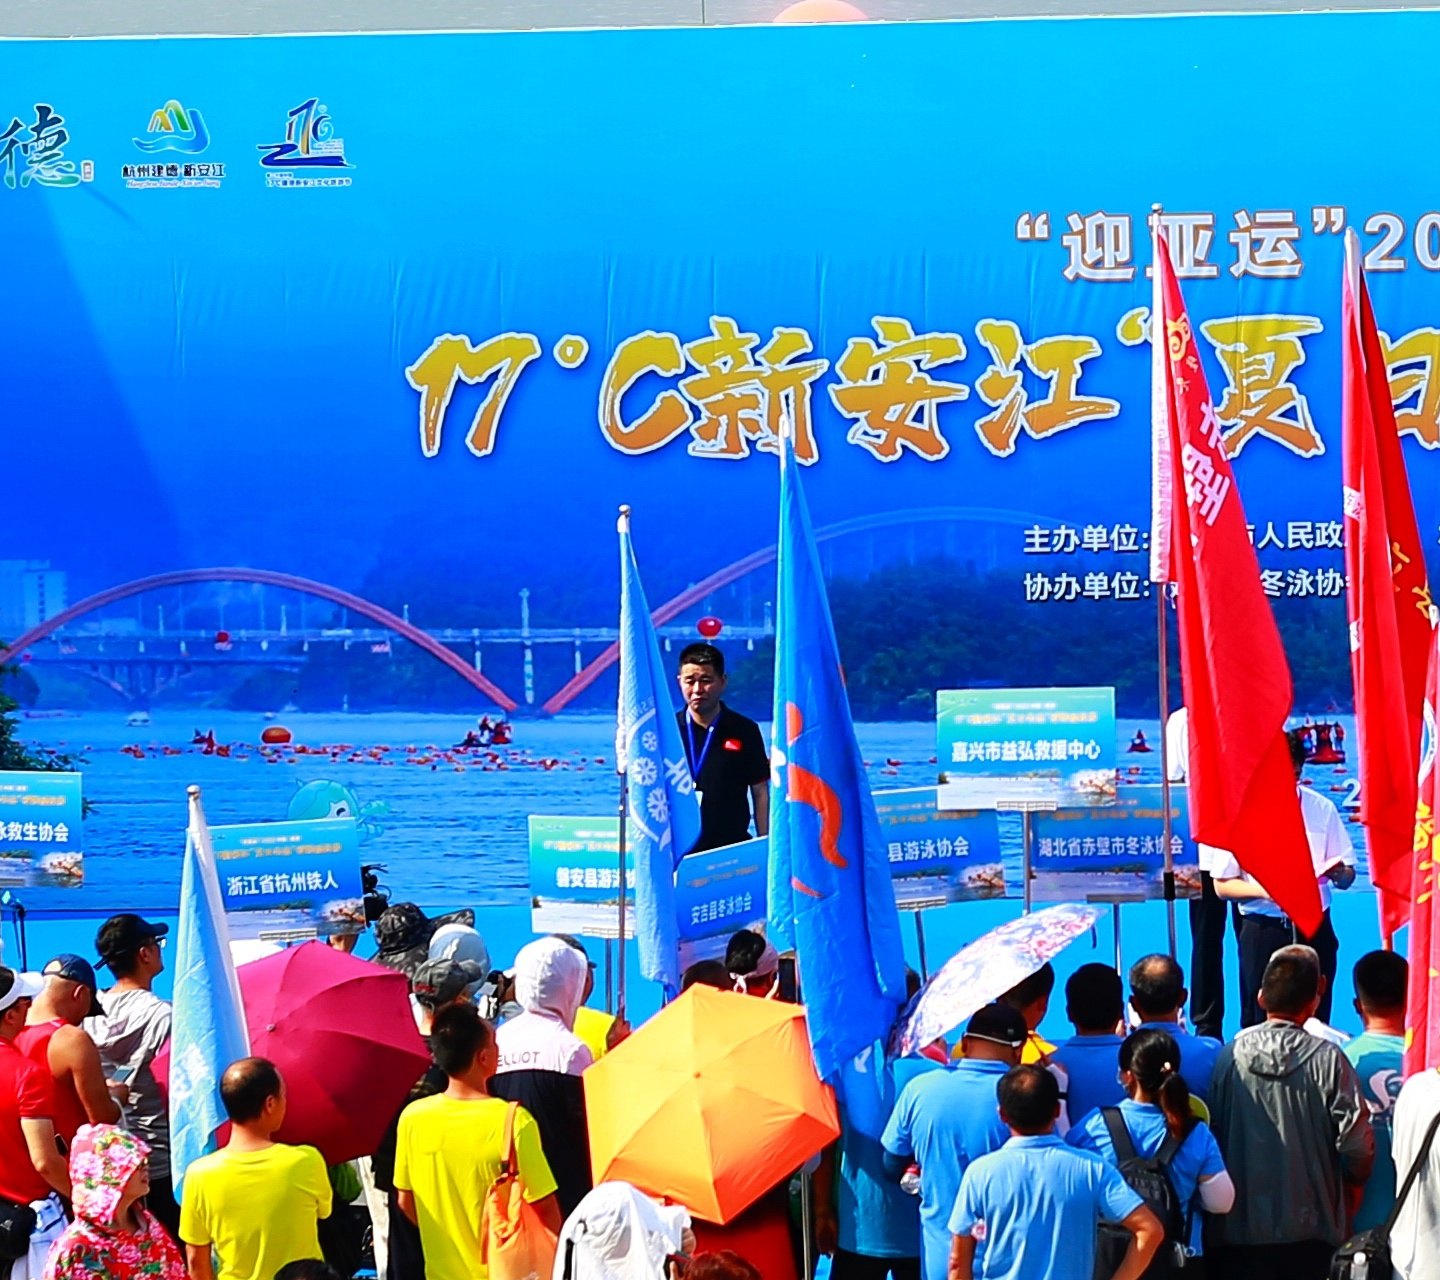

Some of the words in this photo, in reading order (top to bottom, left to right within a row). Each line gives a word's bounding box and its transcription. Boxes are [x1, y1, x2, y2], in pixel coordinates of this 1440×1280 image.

[951, 740, 1101, 763] 嘉兴市益弘救援中心
[887, 836, 970, 863] 县游泳协会
[227, 866, 340, 898] 浙江省杭州铁人
[690, 892, 754, 927] 安吉县冬泳协会
